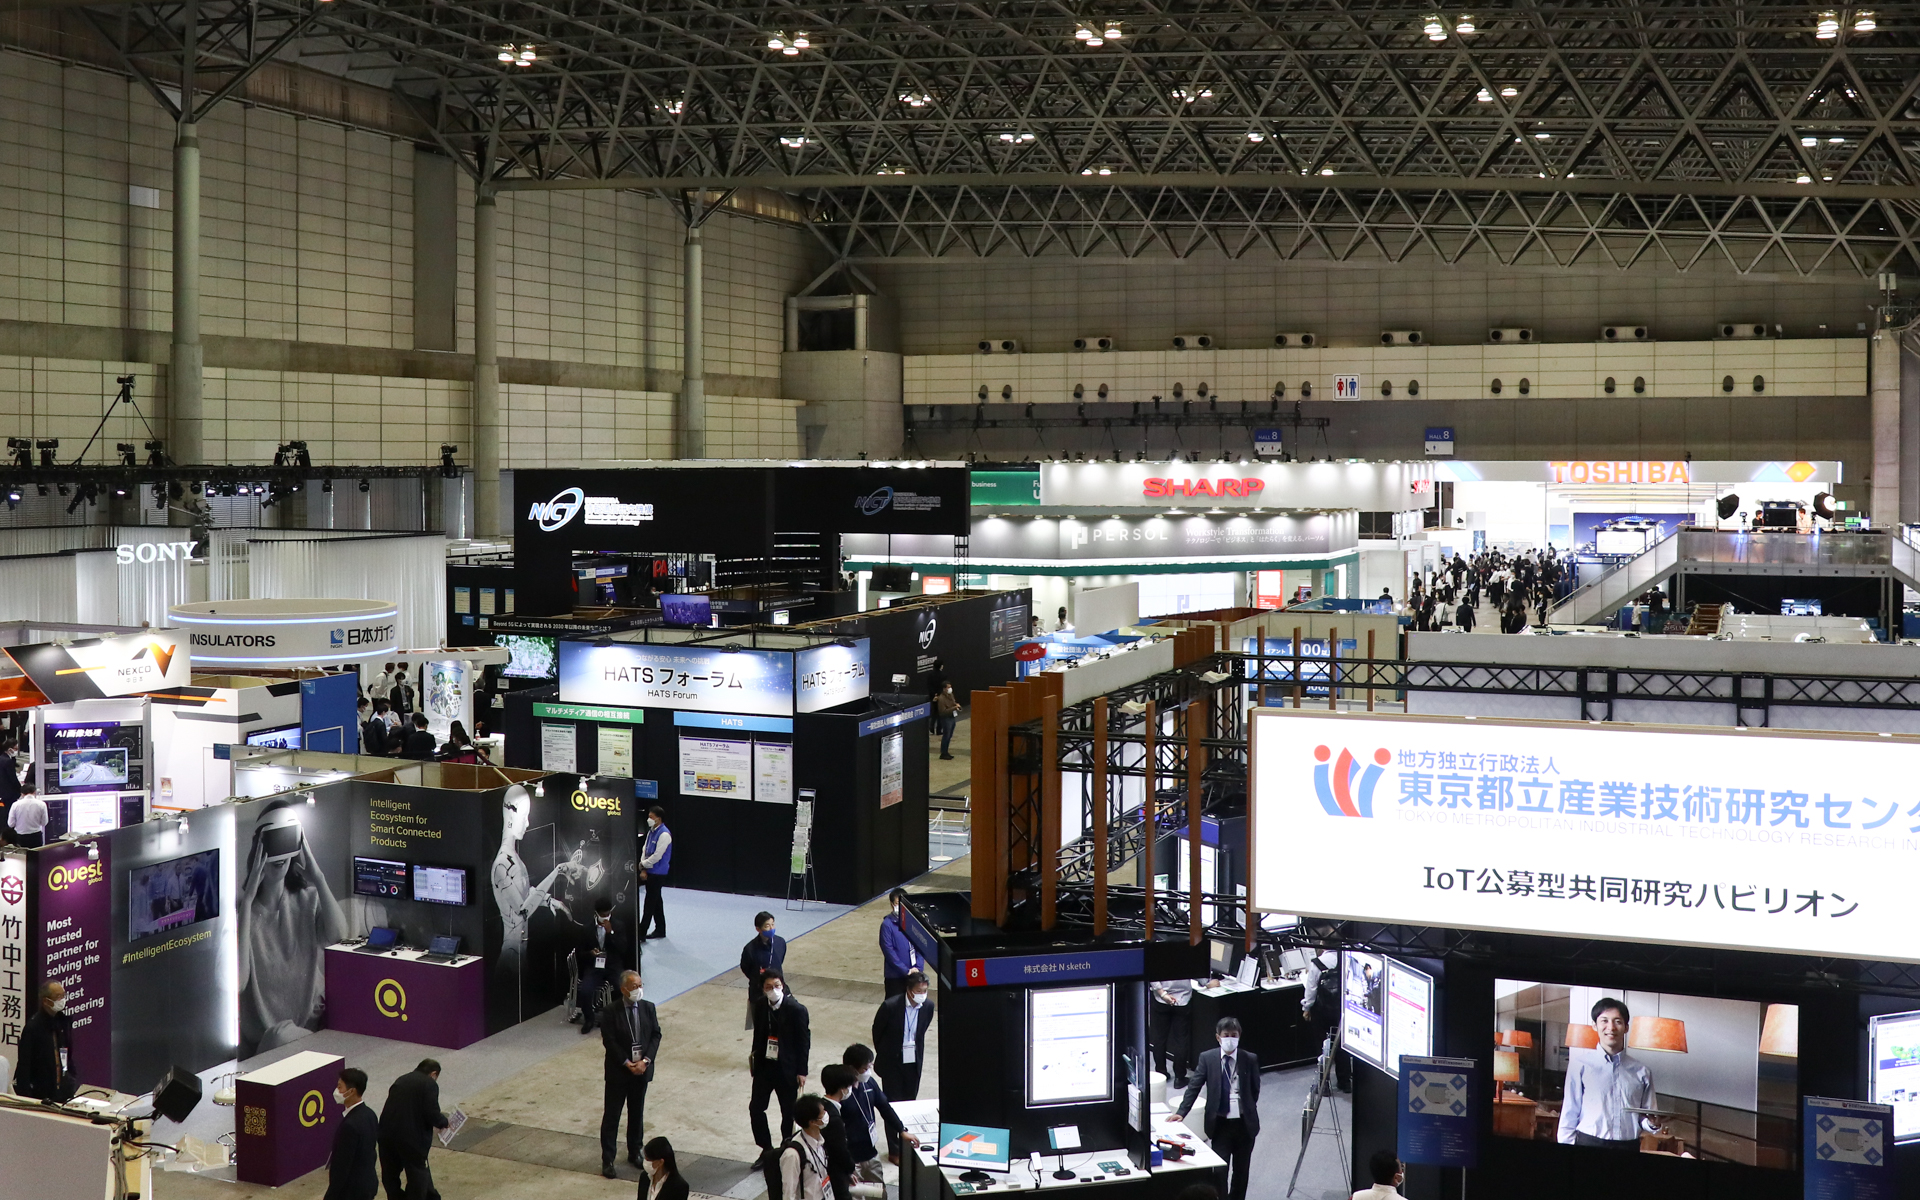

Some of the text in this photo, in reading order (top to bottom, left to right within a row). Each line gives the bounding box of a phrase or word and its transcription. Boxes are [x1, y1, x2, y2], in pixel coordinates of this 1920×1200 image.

[1271, 431, 1278, 440] 8
[1443, 430, 1450, 440] 8
[1549, 461, 1690, 482] TOSHIBA
[1142, 477, 1265, 497] SHARP
[1092, 527, 1168, 543] PERSOL
[1185, 527, 1285, 537] Workstyle Transformation
[117, 541, 198, 564] SONY
[652, 559, 668, 578] IPA
[190, 634, 276, 647] INSULATORS
[118, 665, 151, 676] NEXCO
[605, 666, 742, 689] HATS フォーラム
[802, 671, 827, 691] HATS
[648, 690, 698, 701] HATS Forum
[545, 706, 631, 720] マルチメディア通信の相互接続
[721, 718, 743, 727] HATS
[1397, 748, 1561, 781] 地方独立行政法人
[370, 798, 411, 811] Intelligent
[571, 790, 622, 812] Quest
[370, 811, 428, 824] Ecosystem for
[370, 823, 442, 839] Smart Connected
[1396, 808, 1448, 825] TOKYO
[1452, 812, 1574, 831] METROPOLITAN
[1579, 819, 1674, 837] INDUSTRIAL
[1680, 825, 1794, 844] TECHNOLOGY
[1801, 832, 1895, 849] RESEARCH
[370, 836, 407, 848] Products
[47, 859, 103, 893] Quest
[88, 876, 103, 887] global
[1423, 867, 1859, 918] IoT公募型共同研究パビリオン
[46, 916, 72, 932] Most
[46, 928, 82, 947] trusted
[122, 930, 212, 964] #IntelligentEcosystem
[46, 937, 99, 965] partner for
[46, 953, 100, 979] solving the
[971, 962, 1091, 978] 8 株式会社 N sketch
[1, 914, 23, 1046] 竹中工務店
[63, 997, 105, 1016] ineering
